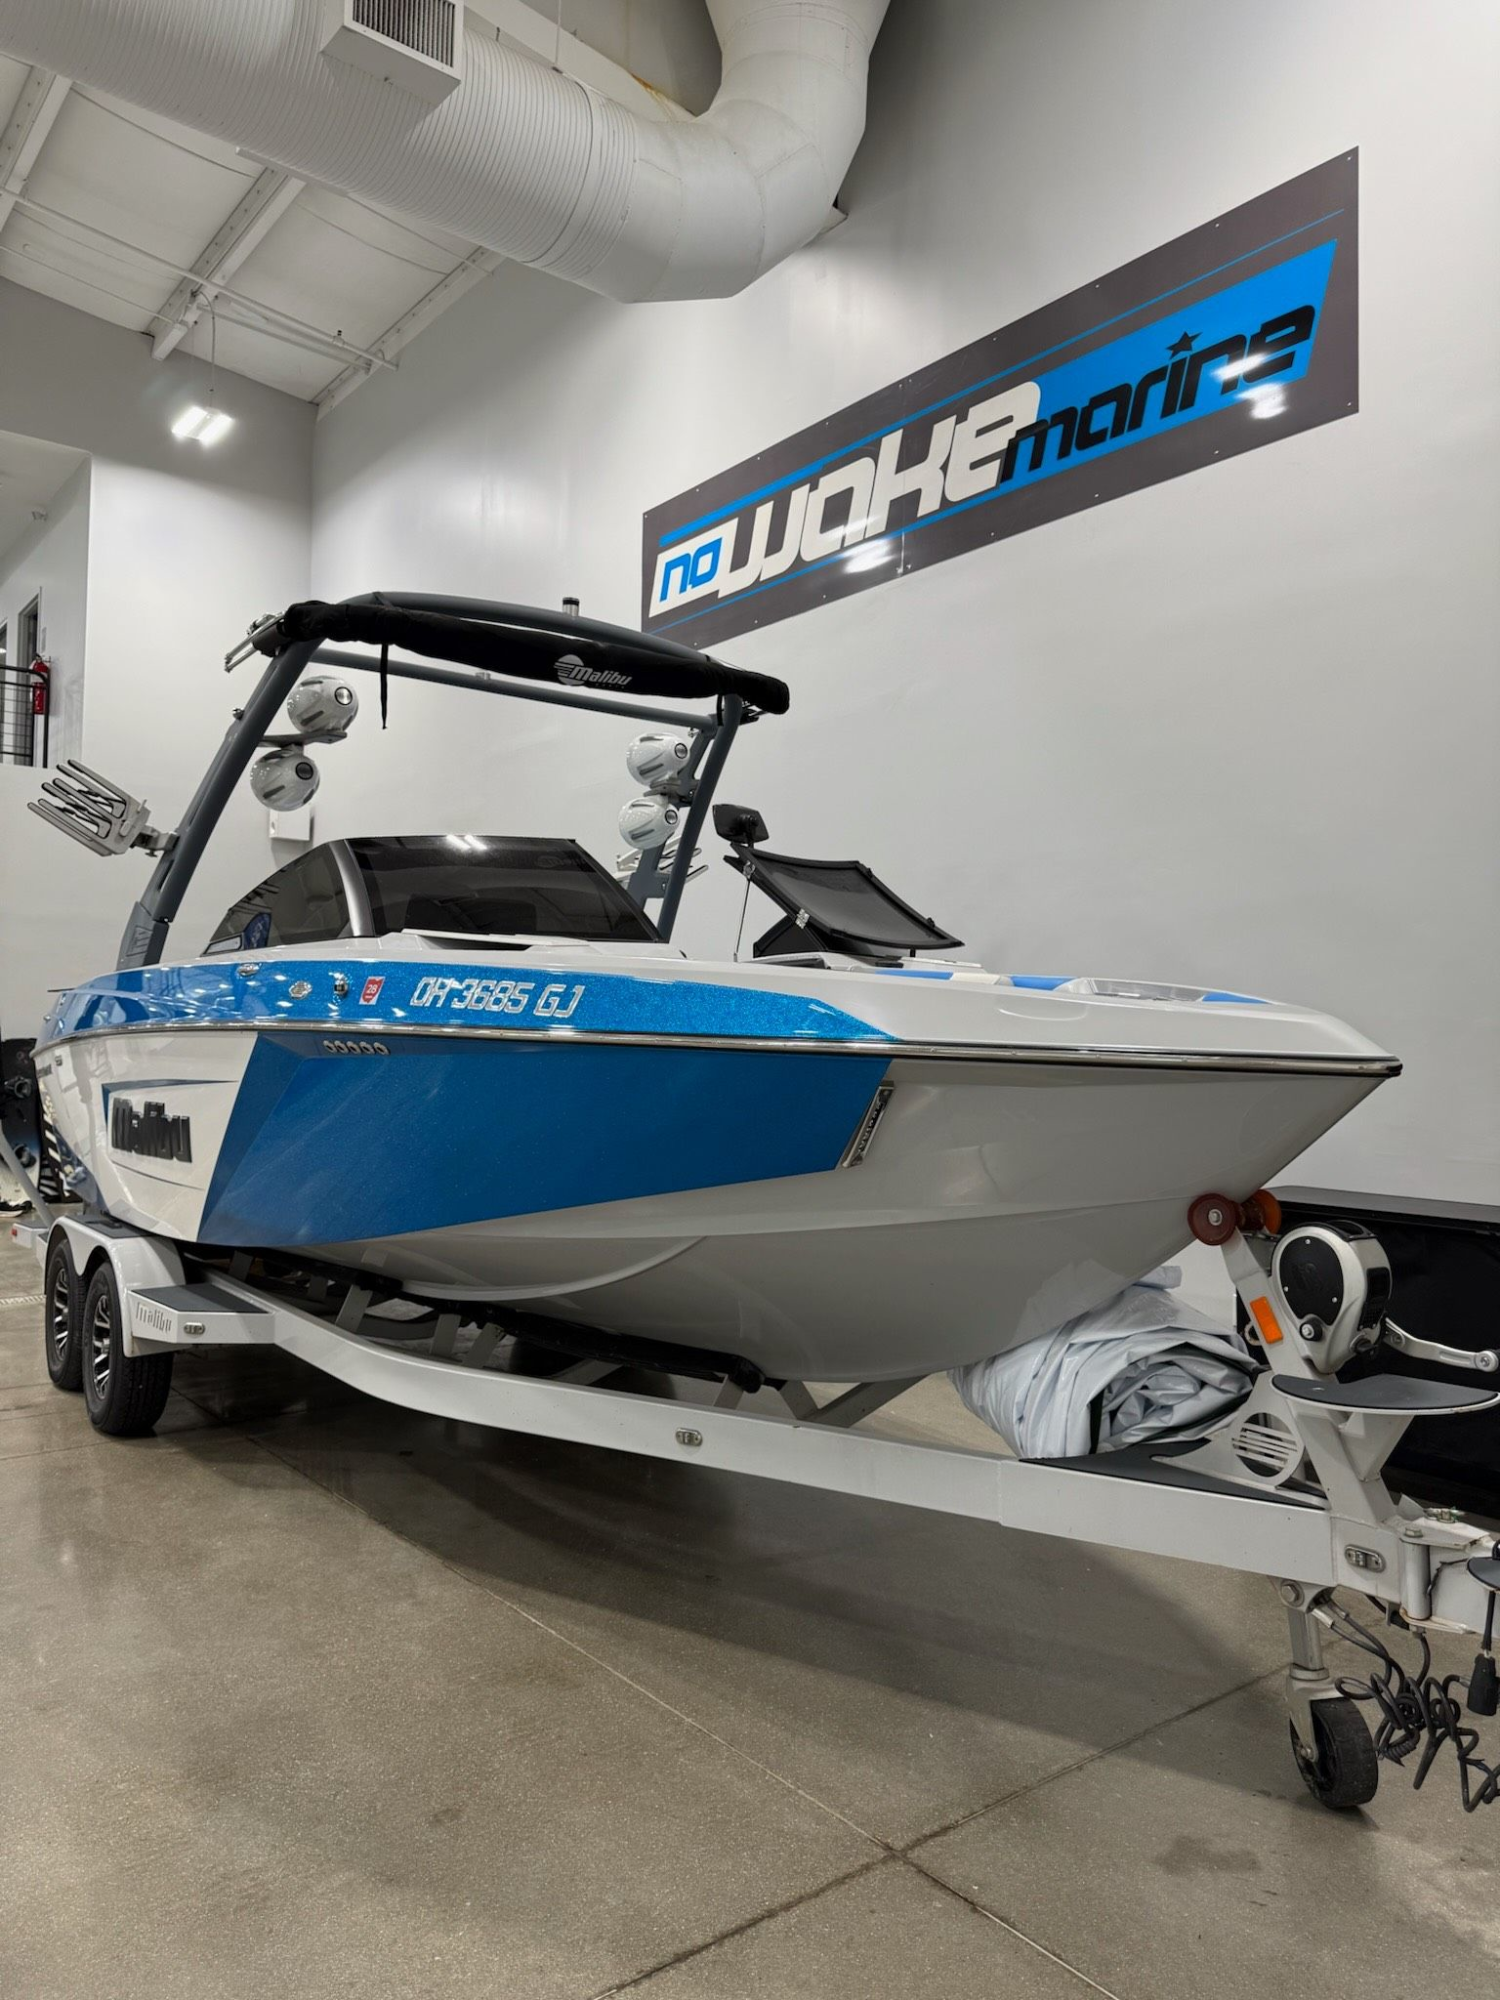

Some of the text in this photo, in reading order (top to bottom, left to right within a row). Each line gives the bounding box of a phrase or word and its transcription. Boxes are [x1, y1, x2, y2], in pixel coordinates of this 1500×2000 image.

[1000, 305, 1316, 484] marine
[568, 665, 633, 685] Malibu
[451, 978, 535, 1014] 3685
[533, 983, 586, 1019] GJ
